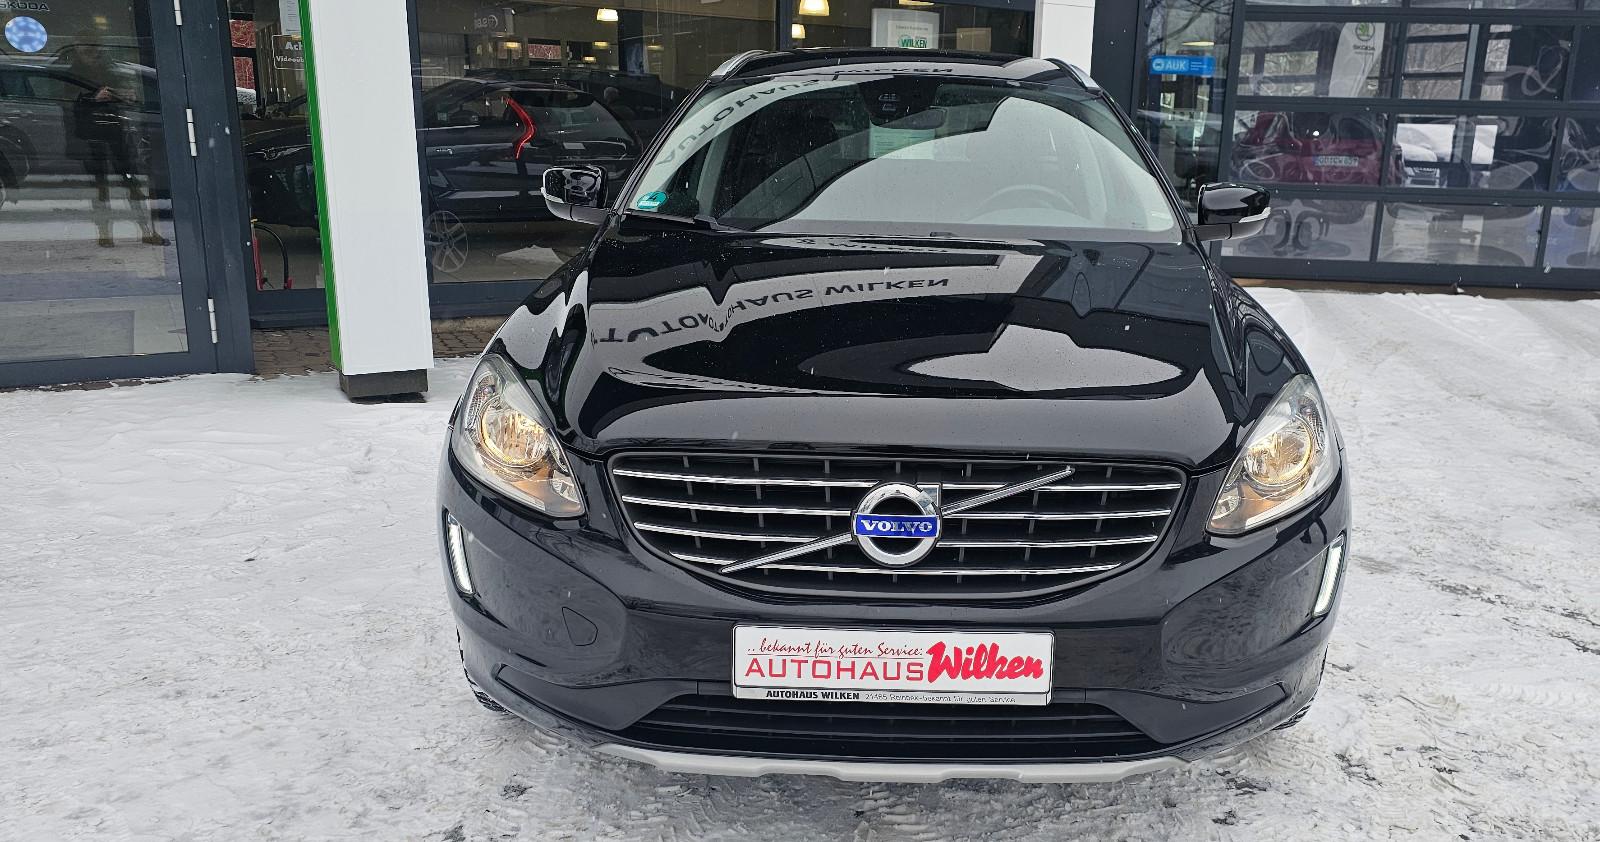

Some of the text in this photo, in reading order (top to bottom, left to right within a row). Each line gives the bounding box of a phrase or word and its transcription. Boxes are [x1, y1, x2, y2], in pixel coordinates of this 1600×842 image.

[901, 38, 927, 48] WILKEN
[1165, 59, 1185, 70] AUK
[861, 520, 933, 534] VOLVO
[759, 638, 812, 654] bekannt
[813, 640, 836, 659] für
[837, 643, 874, 659] guten
[876, 642, 924, 658] Service:
[744, 640, 1045, 684] AUTOHAUS Wilken
[766, 690, 818, 699] AUTOHAUS
[821, 691, 860, 700] WILKEN
